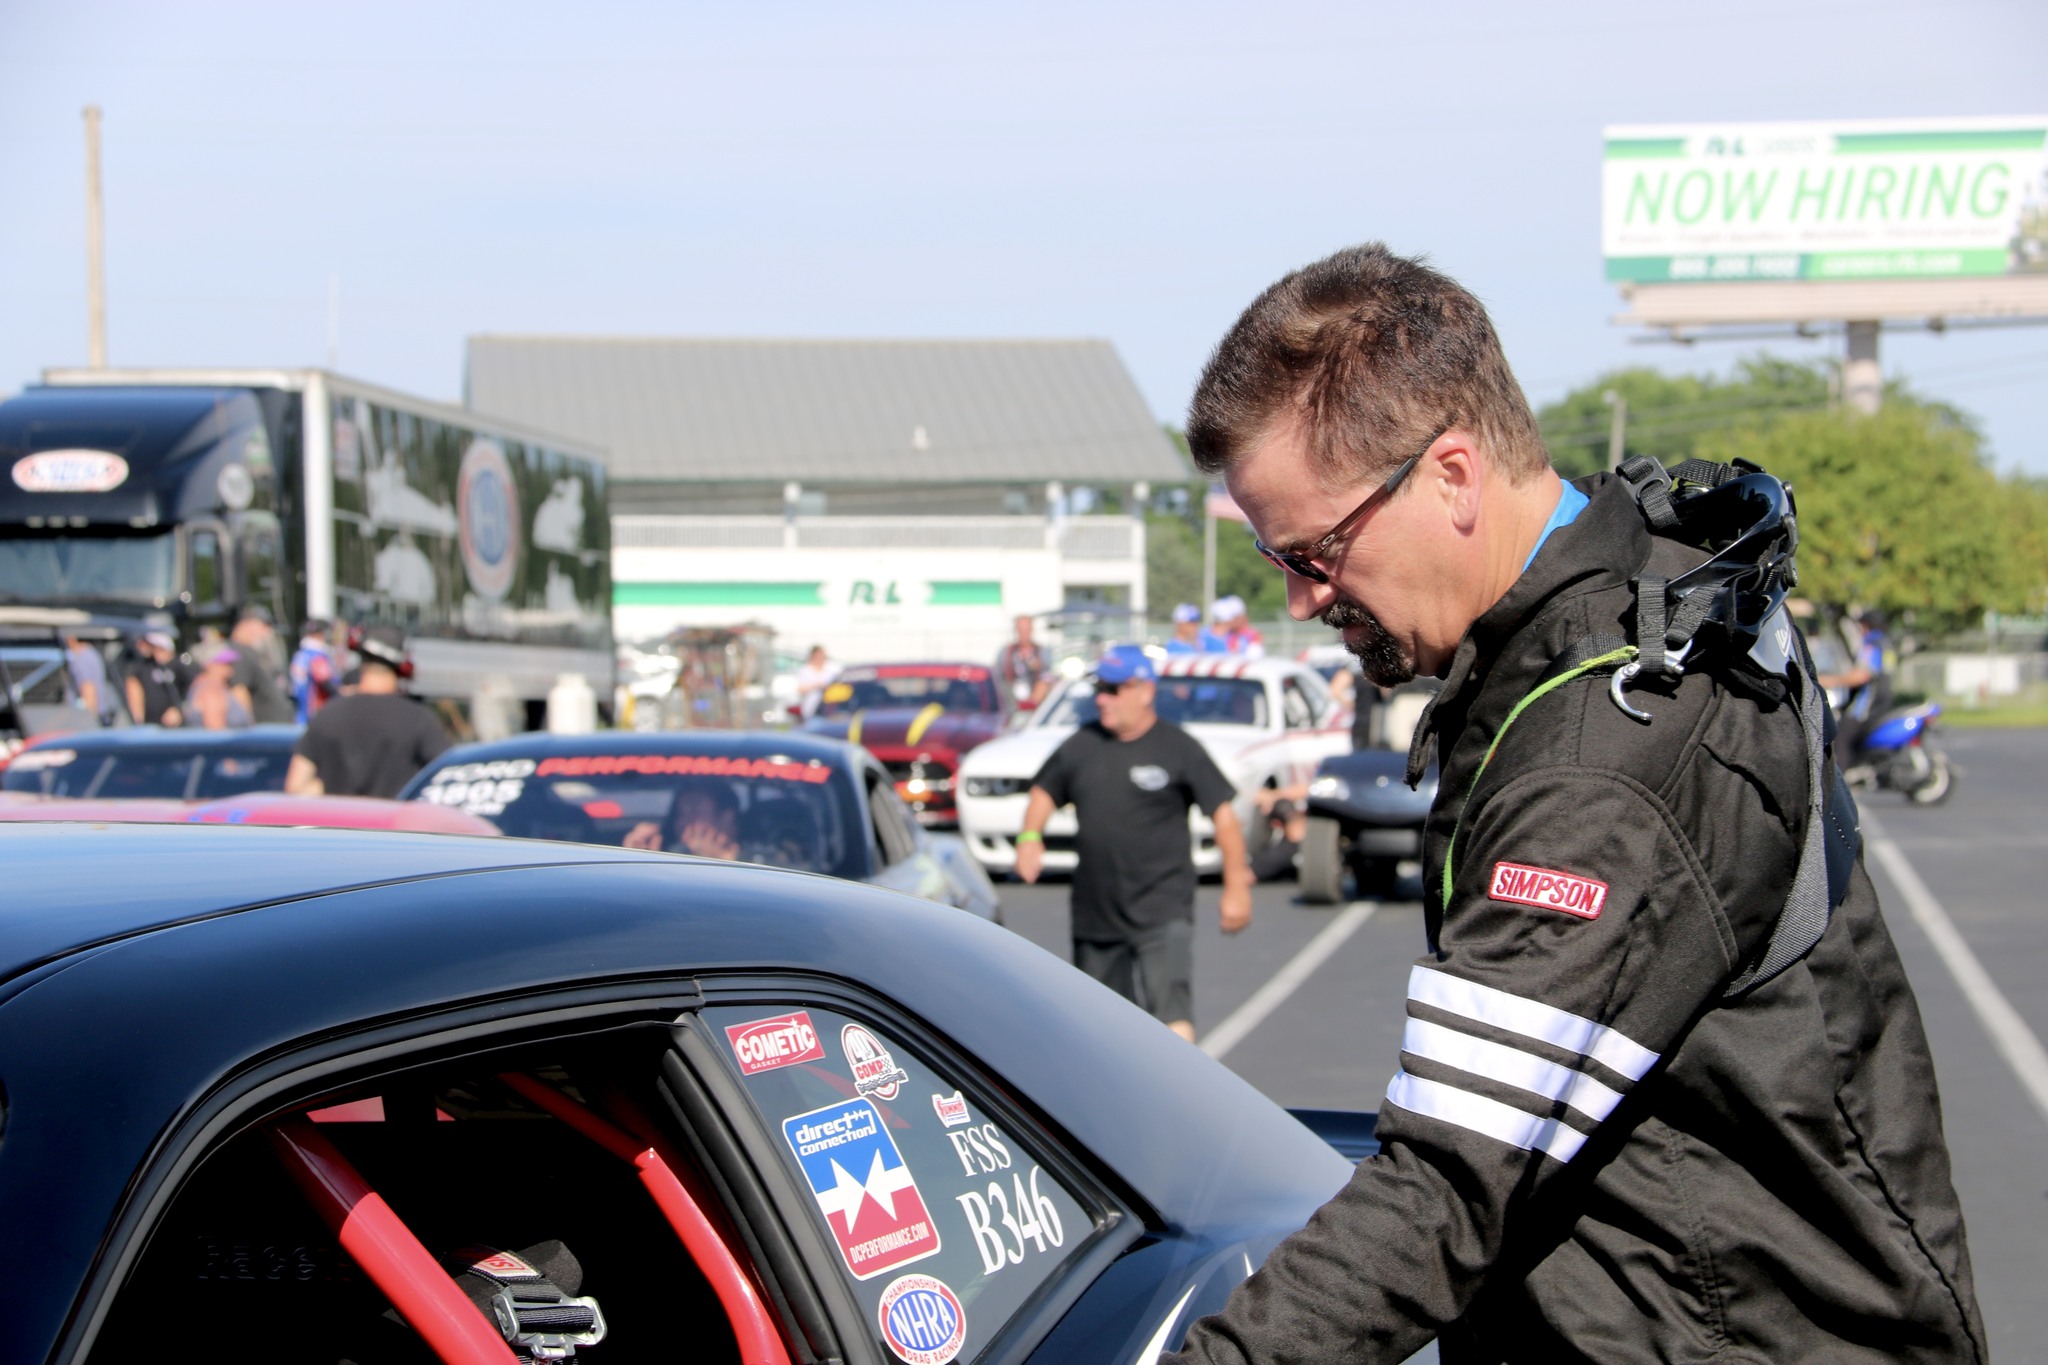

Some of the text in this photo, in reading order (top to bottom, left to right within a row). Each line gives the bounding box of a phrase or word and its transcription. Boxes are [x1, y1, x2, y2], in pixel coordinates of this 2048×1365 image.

[1624, 162, 2011, 225] NOW HIRING
[535, 755, 832, 784] PERFORMANCE
[1496, 869, 1599, 912] SIMPSON
[736, 1024, 816, 1064] COMETIC
[751, 1058, 781, 1070] GASKET
[856, 1060, 883, 1080] COMP
[795, 1111, 854, 1144] direct
[799, 1125, 877, 1157] connection
[946, 1122, 1011, 1177] FSS
[955, 1165, 1063, 1275] B346
[849, 1221, 930, 1265] DCPERFORMANCE.COM
[885, 1278, 938, 1305] CHAMPIONSHIP
[891, 1292, 955, 1348] NHRA
[906, 1337, 960, 1365] DRAG RACING
